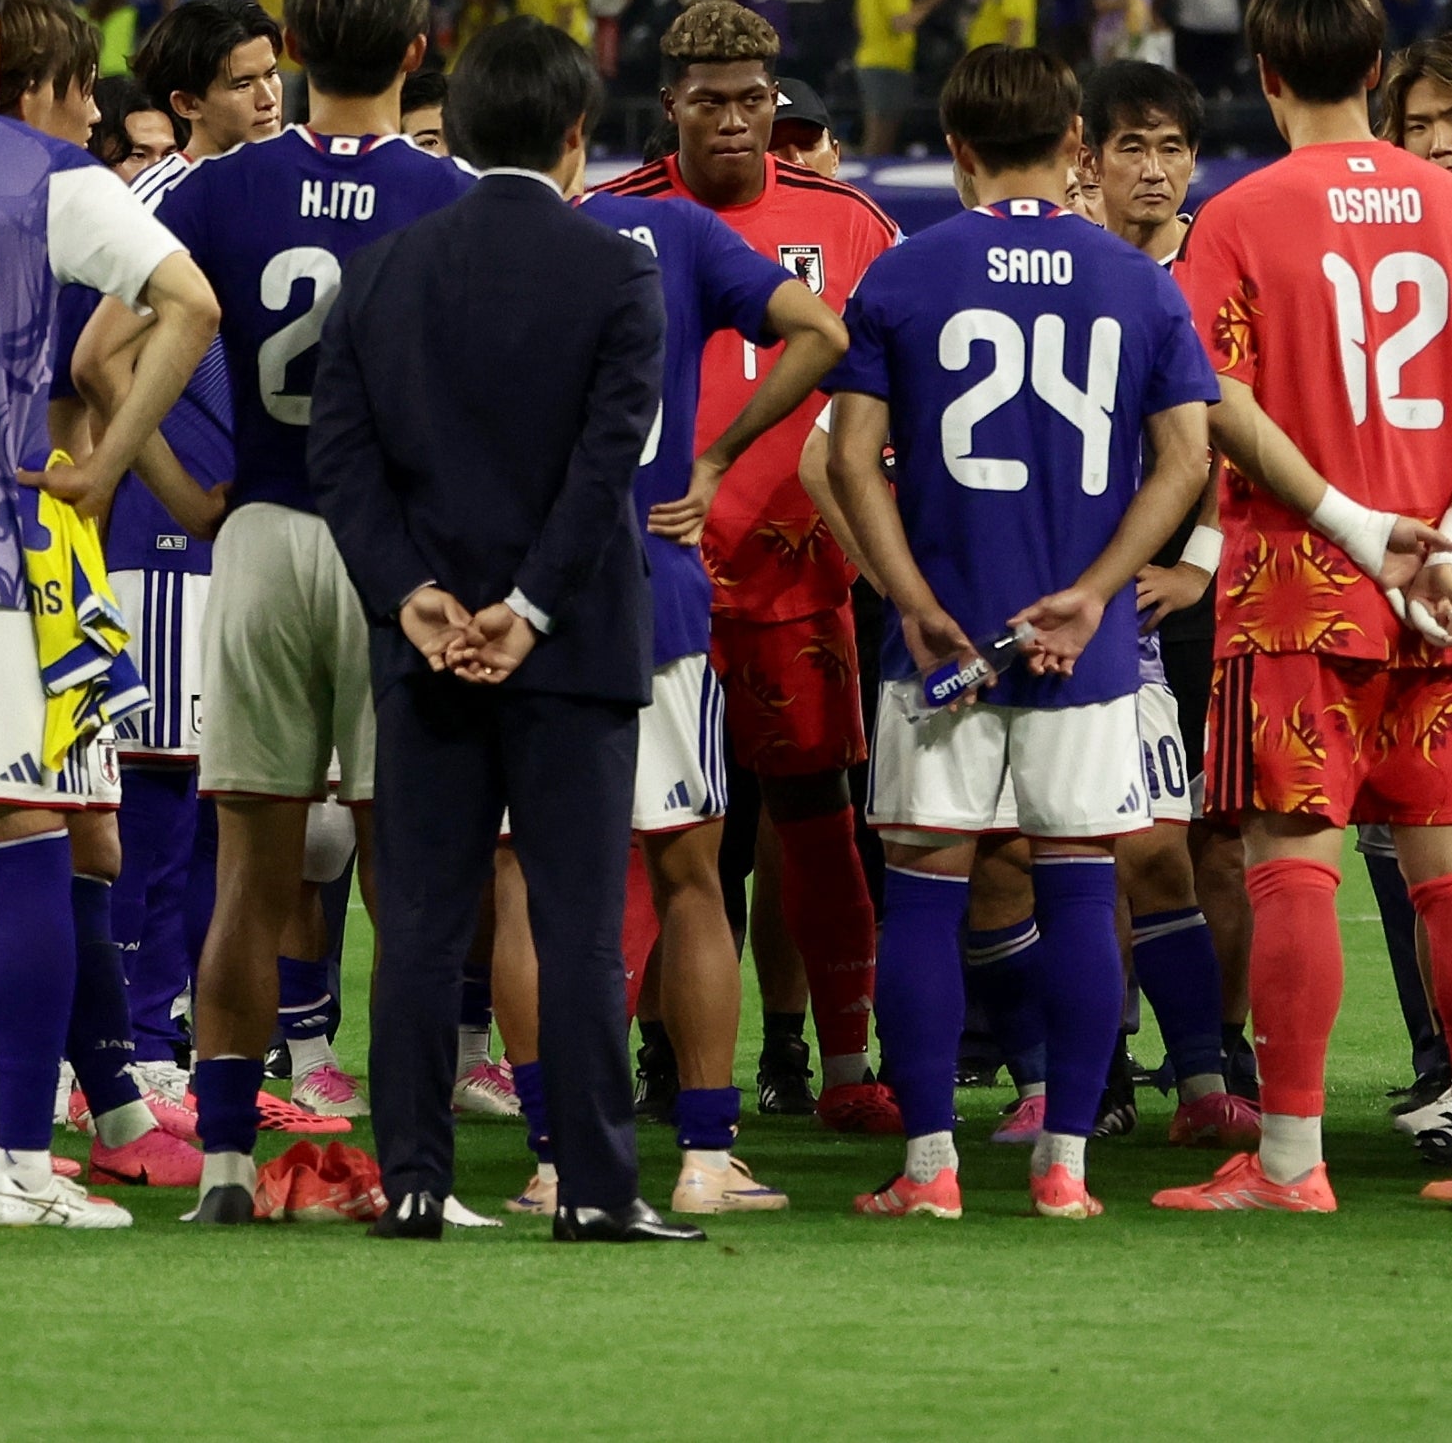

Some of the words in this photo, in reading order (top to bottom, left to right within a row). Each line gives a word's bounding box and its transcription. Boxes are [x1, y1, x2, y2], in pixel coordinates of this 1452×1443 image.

[300, 179, 375, 220] H.ITO
[1327, 187, 1422, 224] OSAKO
[987, 247, 1073, 285] SANO
[1322, 251, 1448, 429] 12
[938, 308, 1122, 496] 24
[932, 658, 988, 699] smart
